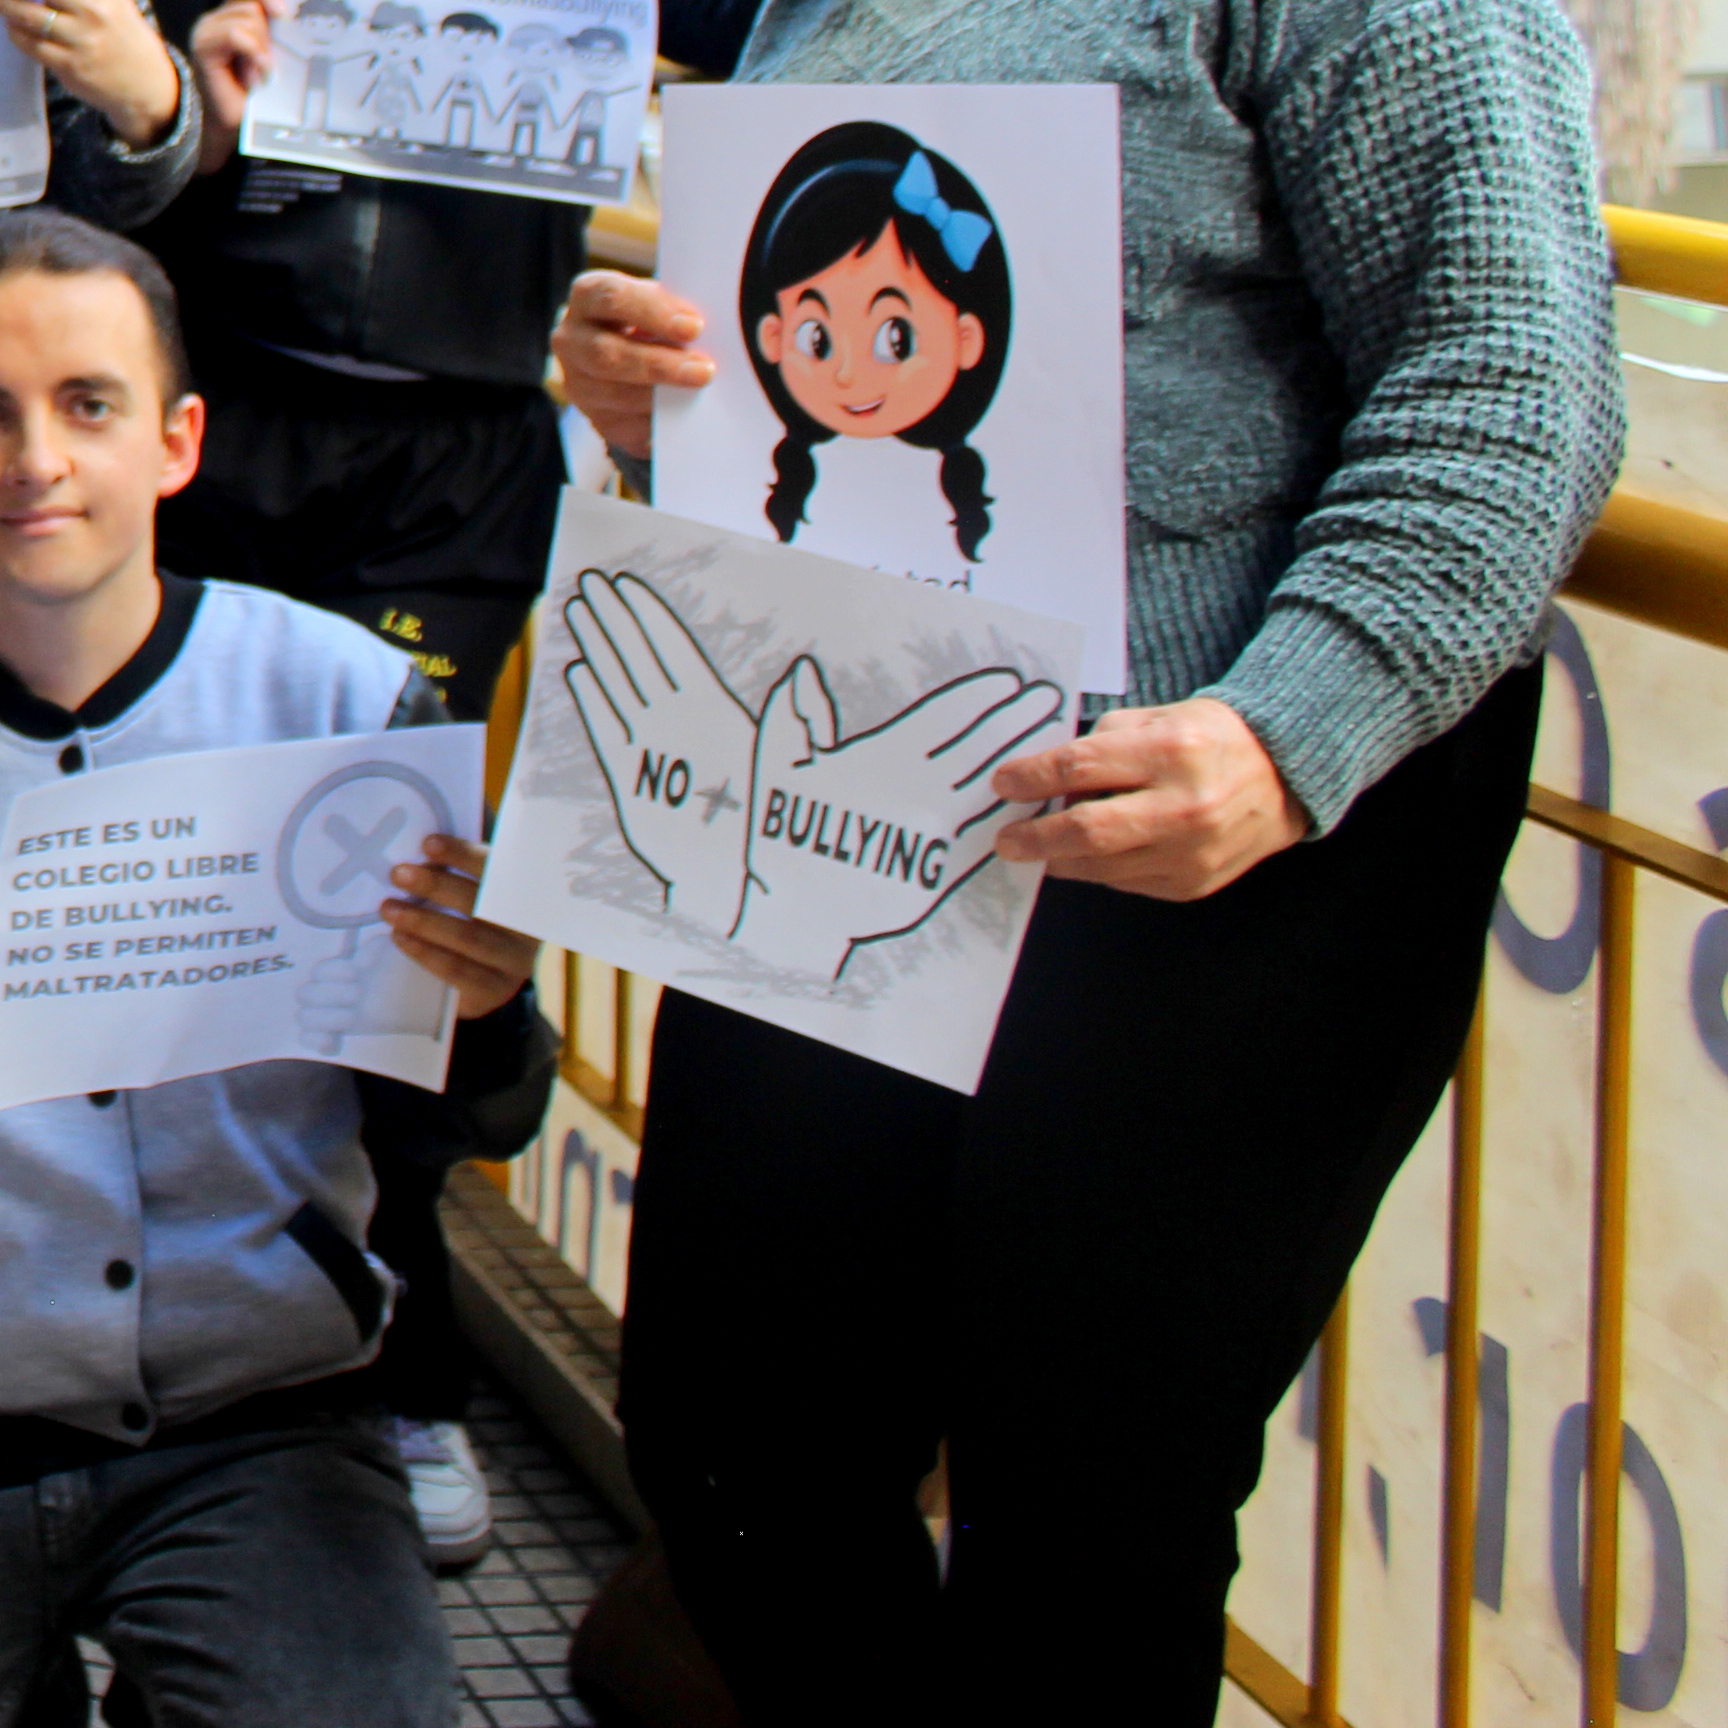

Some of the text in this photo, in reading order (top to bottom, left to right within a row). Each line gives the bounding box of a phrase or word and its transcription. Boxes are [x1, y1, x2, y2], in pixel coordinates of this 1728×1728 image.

[17, 815, 198, 856] ESTE ES UN
[634, 747, 692, 809] NO
[759, 787, 951, 891] BULLYING
[12, 851, 261, 893] COLEGIO LIBRE
[10, 893, 234, 932] DE BULLYING.
[6, 924, 279, 967] NO SE PERMITEN
[3, 952, 295, 1002] MALTRATADORES.
